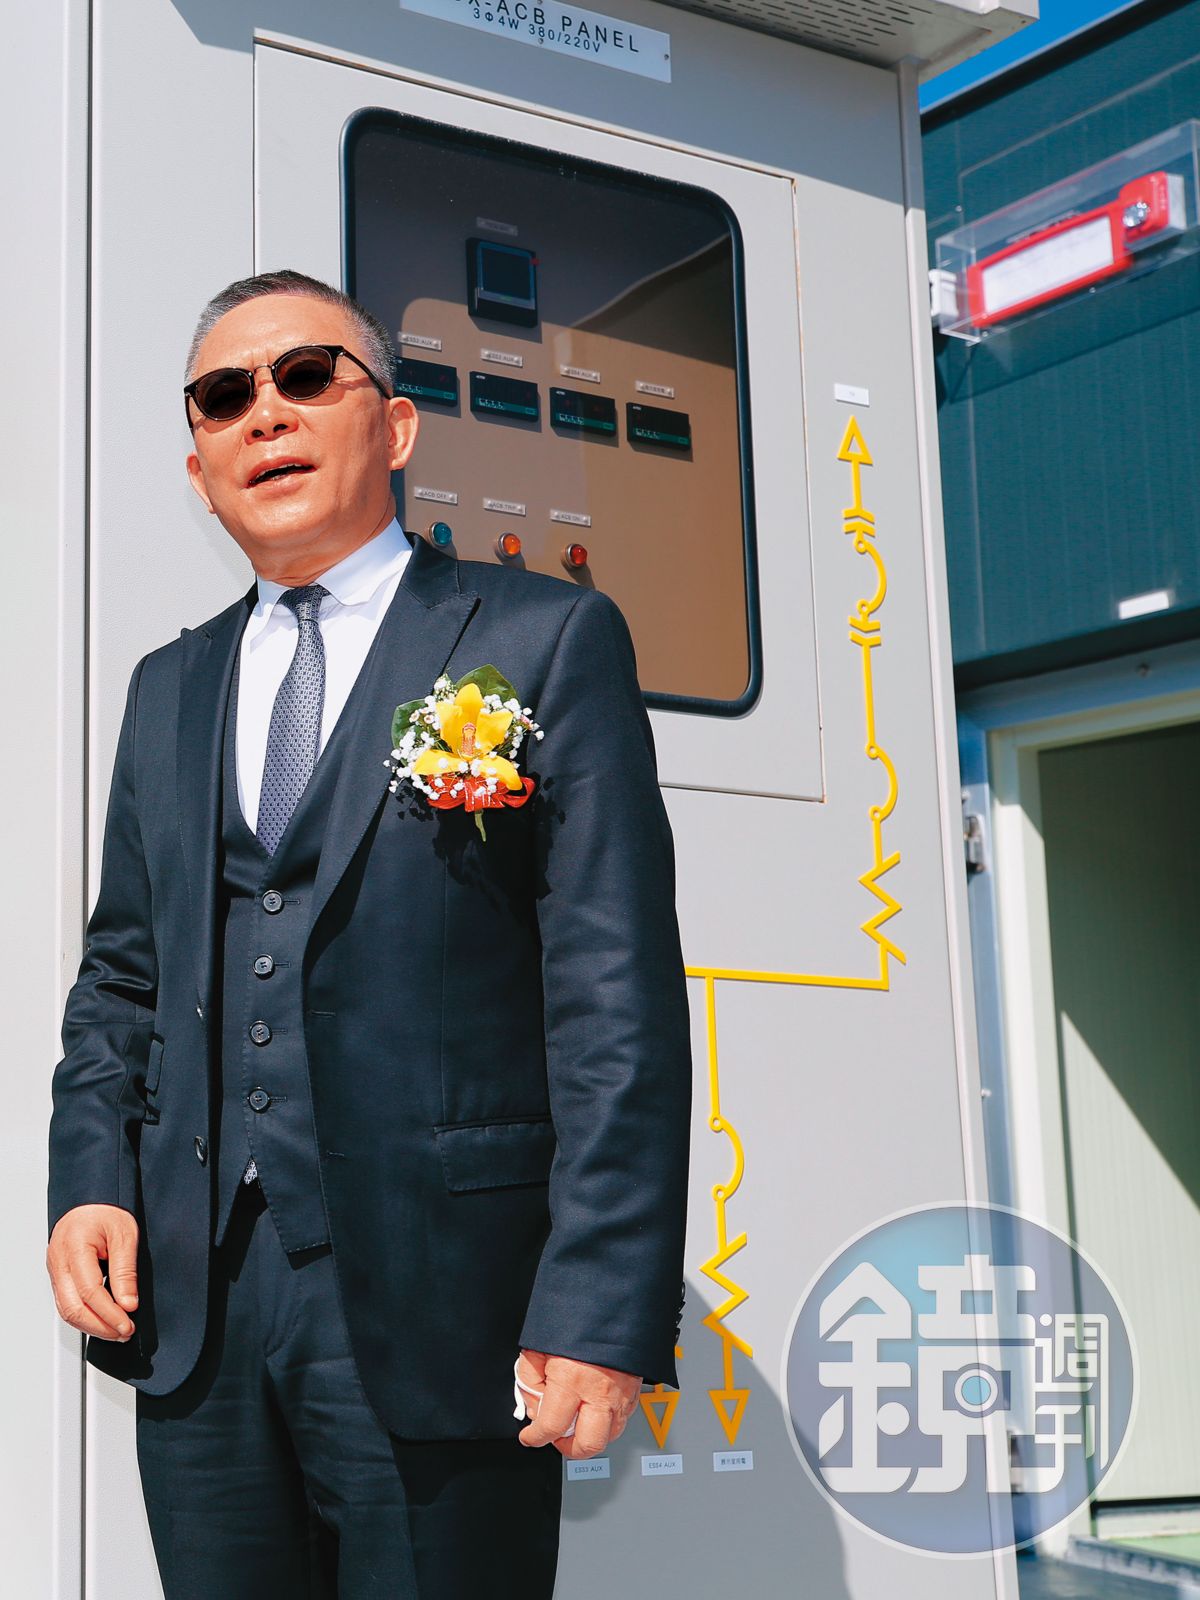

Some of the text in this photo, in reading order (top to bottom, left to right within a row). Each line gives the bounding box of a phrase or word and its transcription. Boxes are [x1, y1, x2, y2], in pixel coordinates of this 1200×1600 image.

[455, 0, 639, 53] -ACB PANEL
[528, 23, 600, 53] 380/220V
[423, 490, 435, 498] ACB
[590, 1464, 603, 1473] AUX
